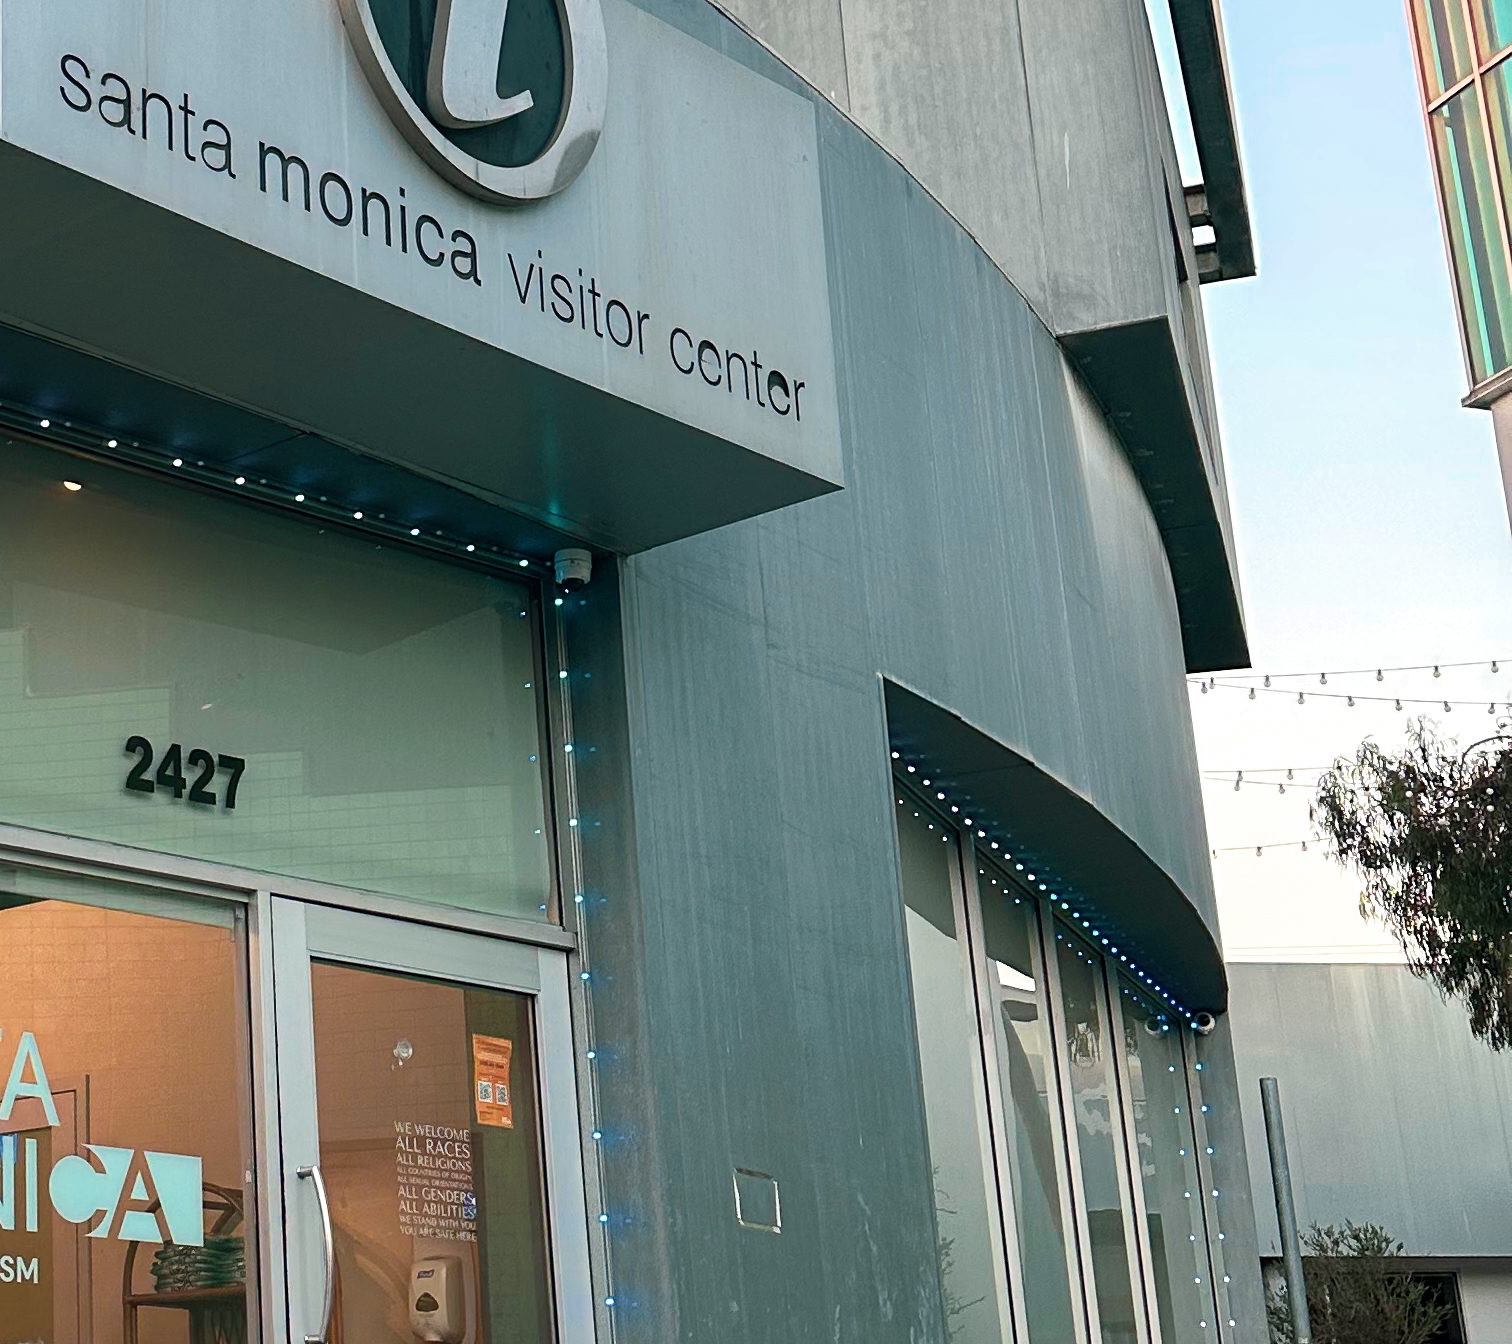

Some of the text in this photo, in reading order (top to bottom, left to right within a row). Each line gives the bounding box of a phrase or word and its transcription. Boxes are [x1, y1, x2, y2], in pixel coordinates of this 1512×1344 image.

[58, 52, 807, 423] santa monica visitor center
[125, 735, 246, 810] 2427
[393, 1120, 471, 1142] WE WELCOME
[395, 1136, 471, 1159] ALL RACES
[395, 1152, 472, 1173] ALL RELIGIONS
[397, 1185, 475, 1204] ALL GENDERS
[398, 1200, 476, 1220] ALL ABILITIES
[399, 1225, 417, 1235] YOU
[439, 1219, 459, 1228] WITH
[459, 1220, 477, 1231] YOU
